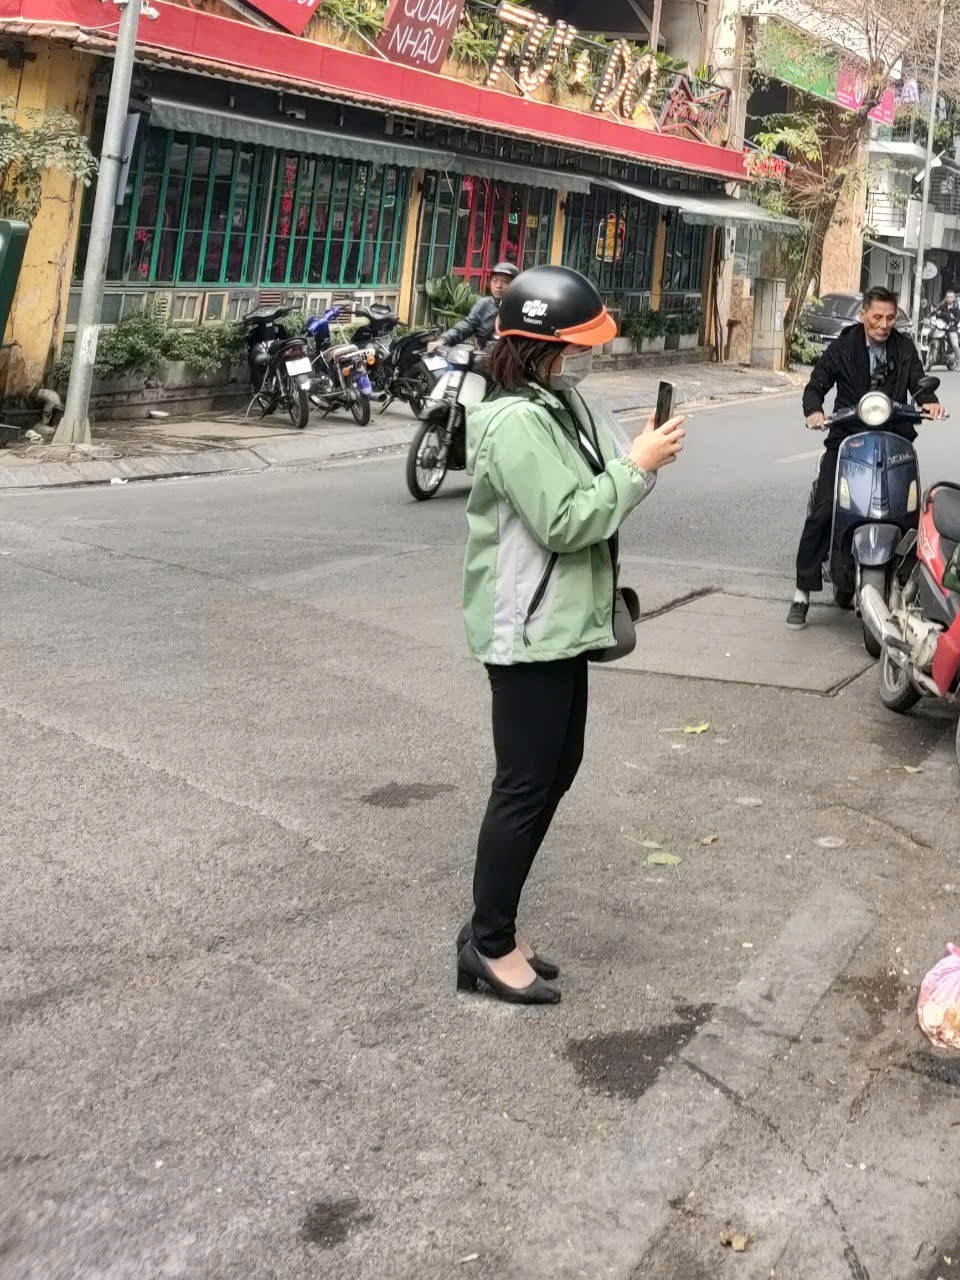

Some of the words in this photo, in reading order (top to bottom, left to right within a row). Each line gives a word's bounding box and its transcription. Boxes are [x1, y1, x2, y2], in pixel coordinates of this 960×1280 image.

[387, 26, 445, 65] NHẬU
[521, 299, 549, 317] FPT
[522, 315, 543, 326] Telecom
